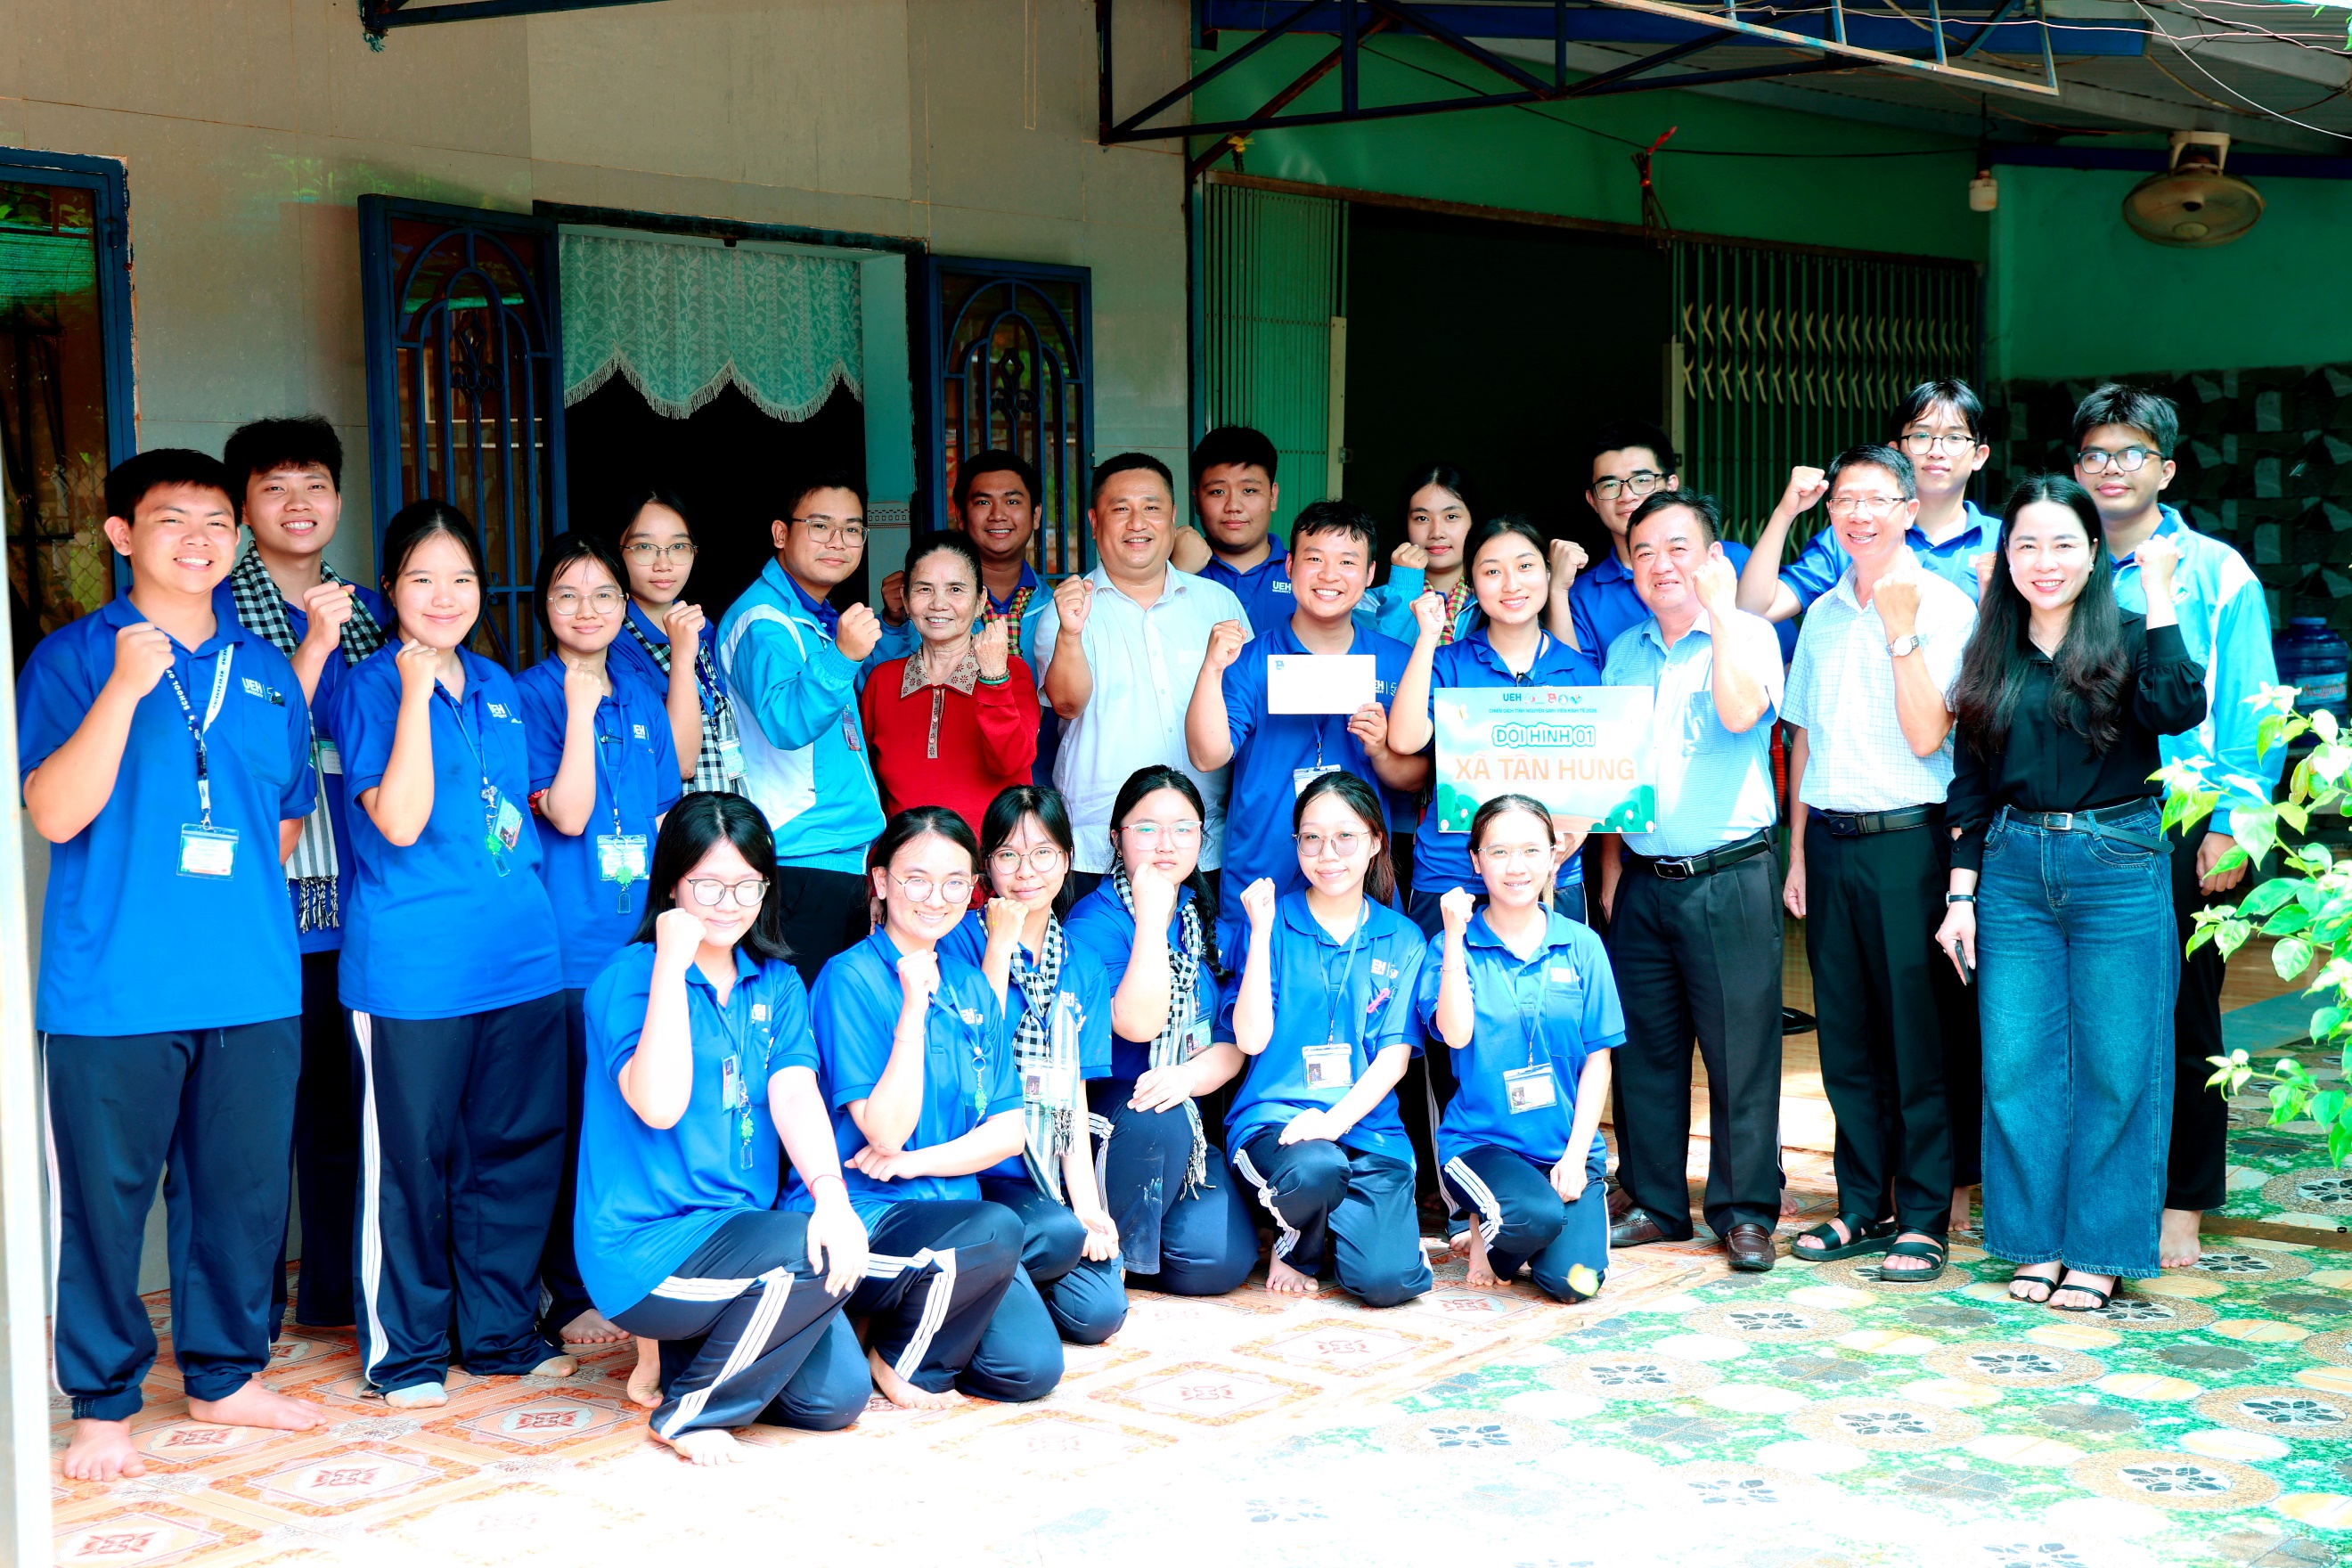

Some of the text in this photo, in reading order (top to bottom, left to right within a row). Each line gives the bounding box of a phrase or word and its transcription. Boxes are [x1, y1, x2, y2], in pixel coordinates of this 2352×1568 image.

[1272, 580, 1292, 591] UEH
[241, 677, 263, 694] UEH
[172, 681, 191, 711] SCHOOL
[1503, 693, 1522, 702] UEH
[1575, 729, 1592, 743] 01
[1455, 753, 1490, 780] XÃ
[1498, 753, 1549, 780] TÂN
